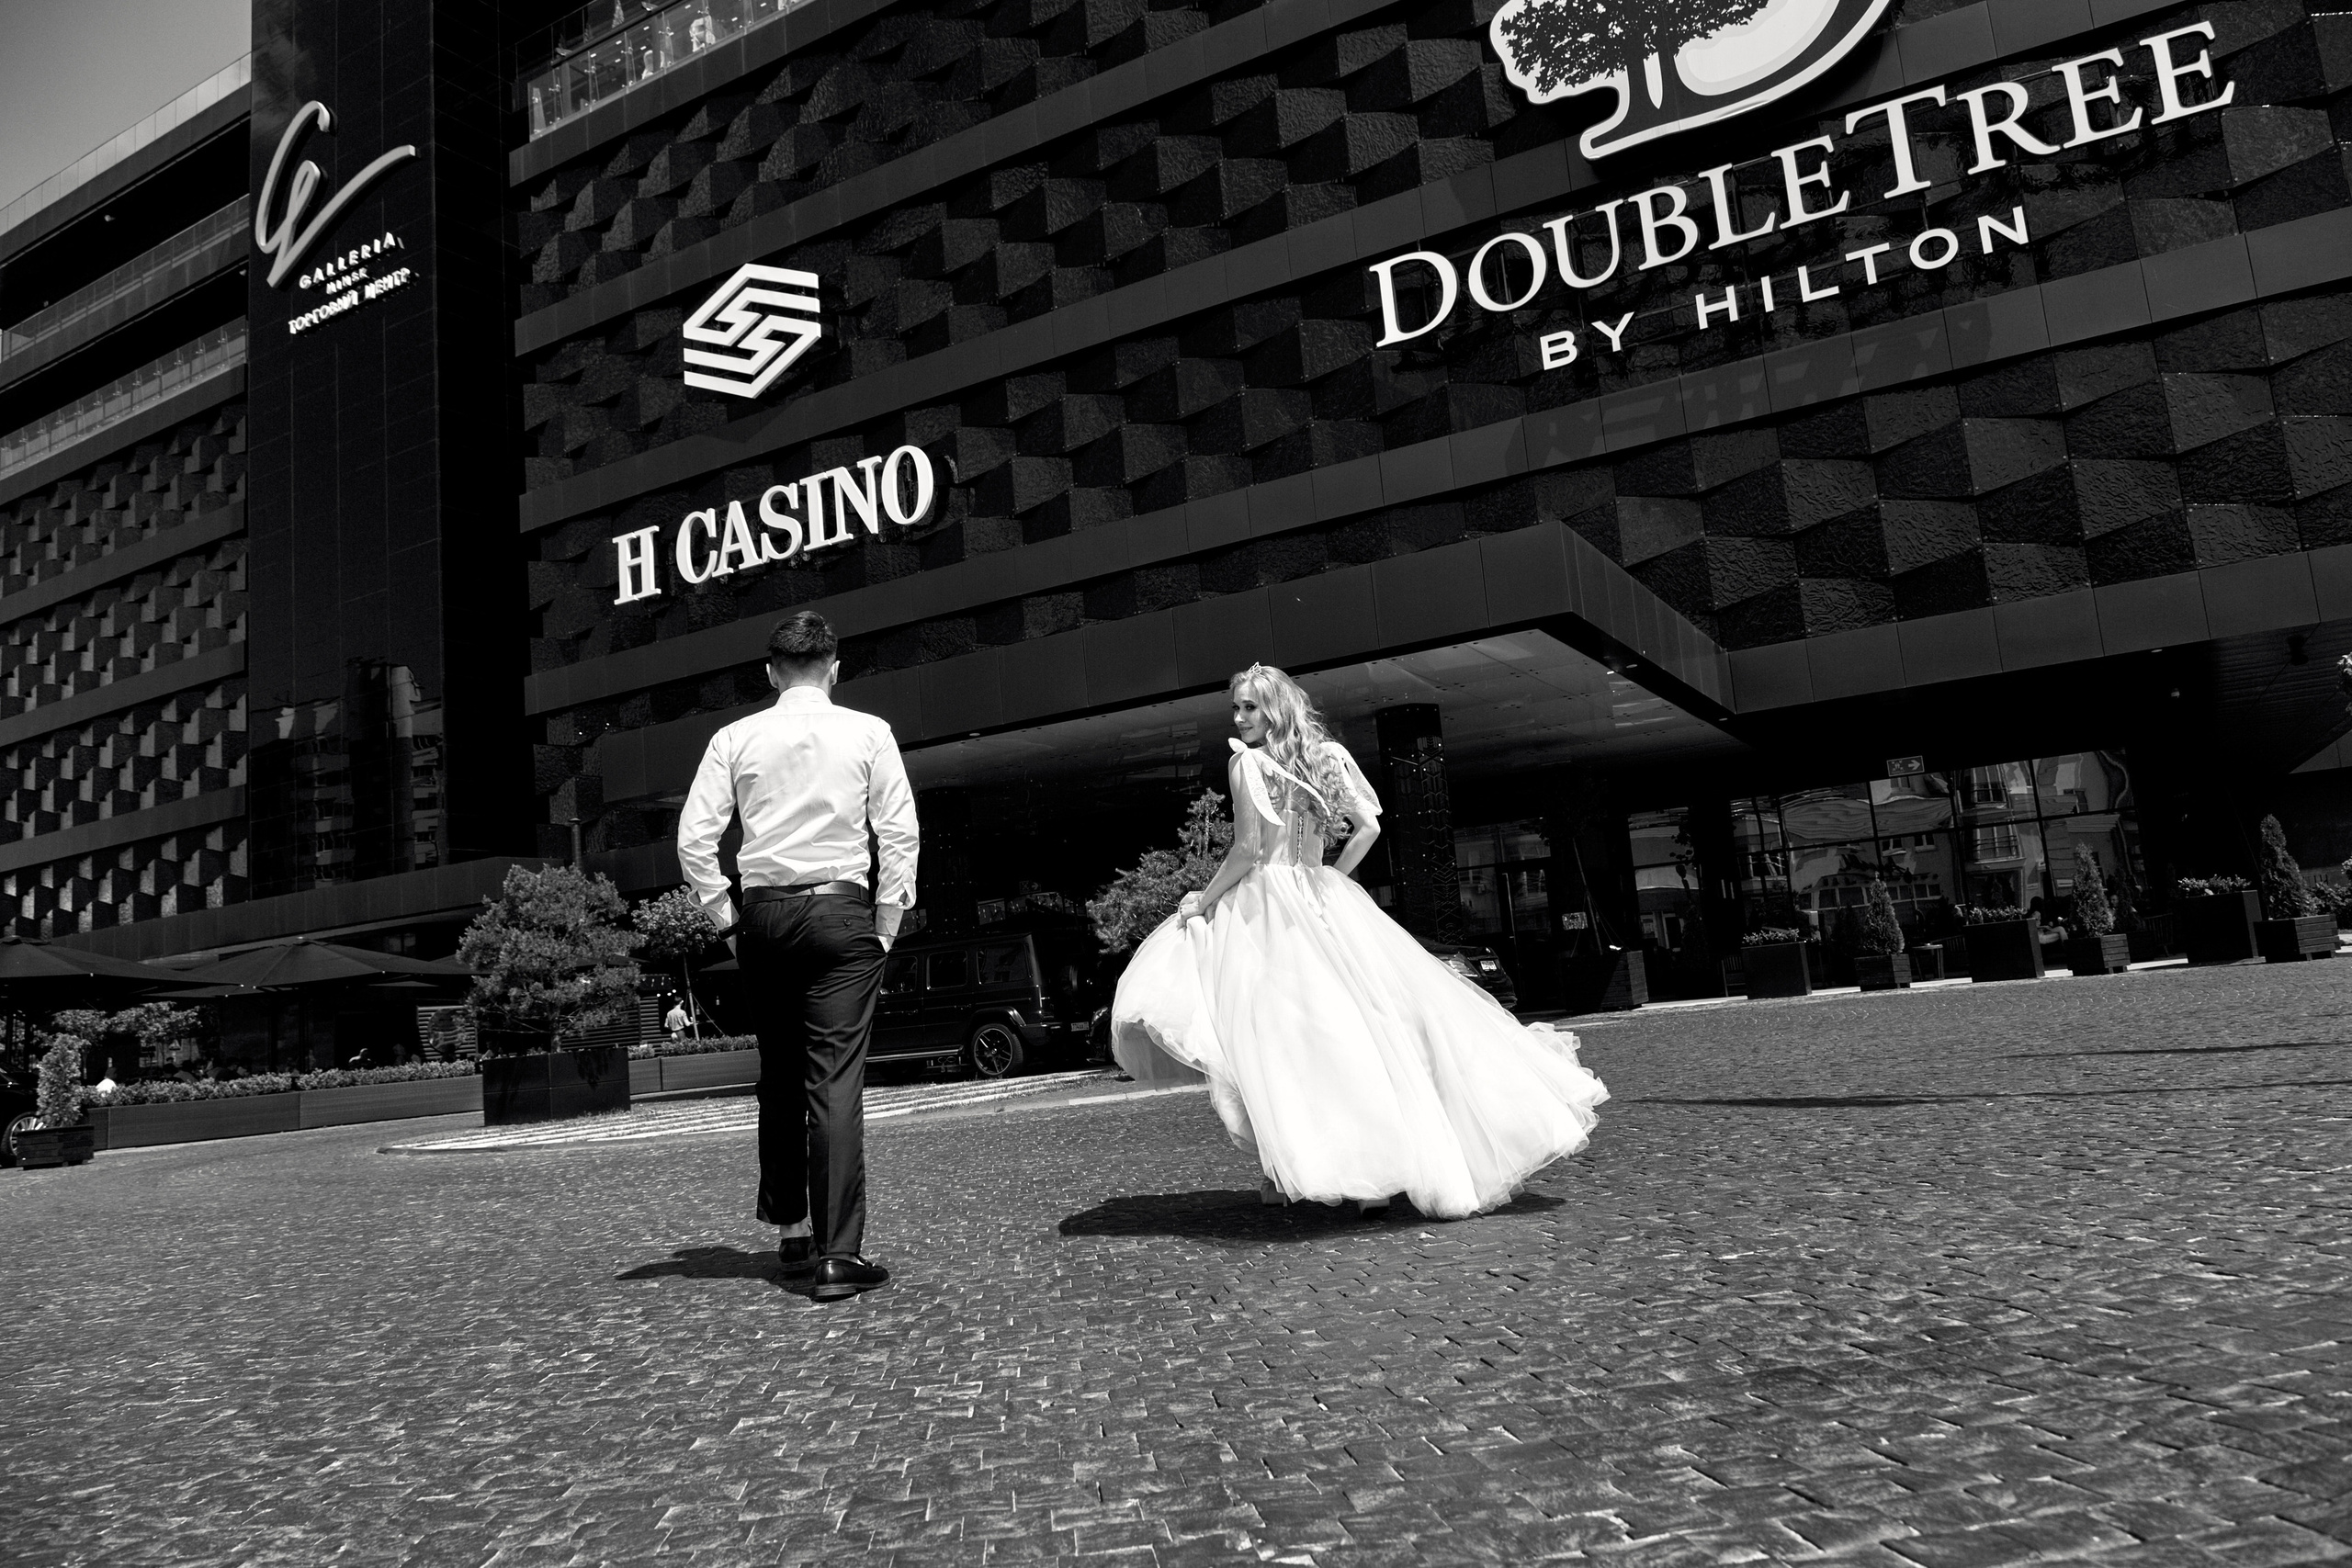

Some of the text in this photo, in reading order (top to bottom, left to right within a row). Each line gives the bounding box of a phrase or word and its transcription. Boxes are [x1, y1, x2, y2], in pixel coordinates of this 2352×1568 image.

[299, 231, 396, 289] GALLERIA
[1368, 20, 2236, 348] DOUBLETREE
[325, 266, 369, 295] MINSK
[1539, 205, 2030, 371] BY HILTON
[612, 445, 934, 605] H CASINO
